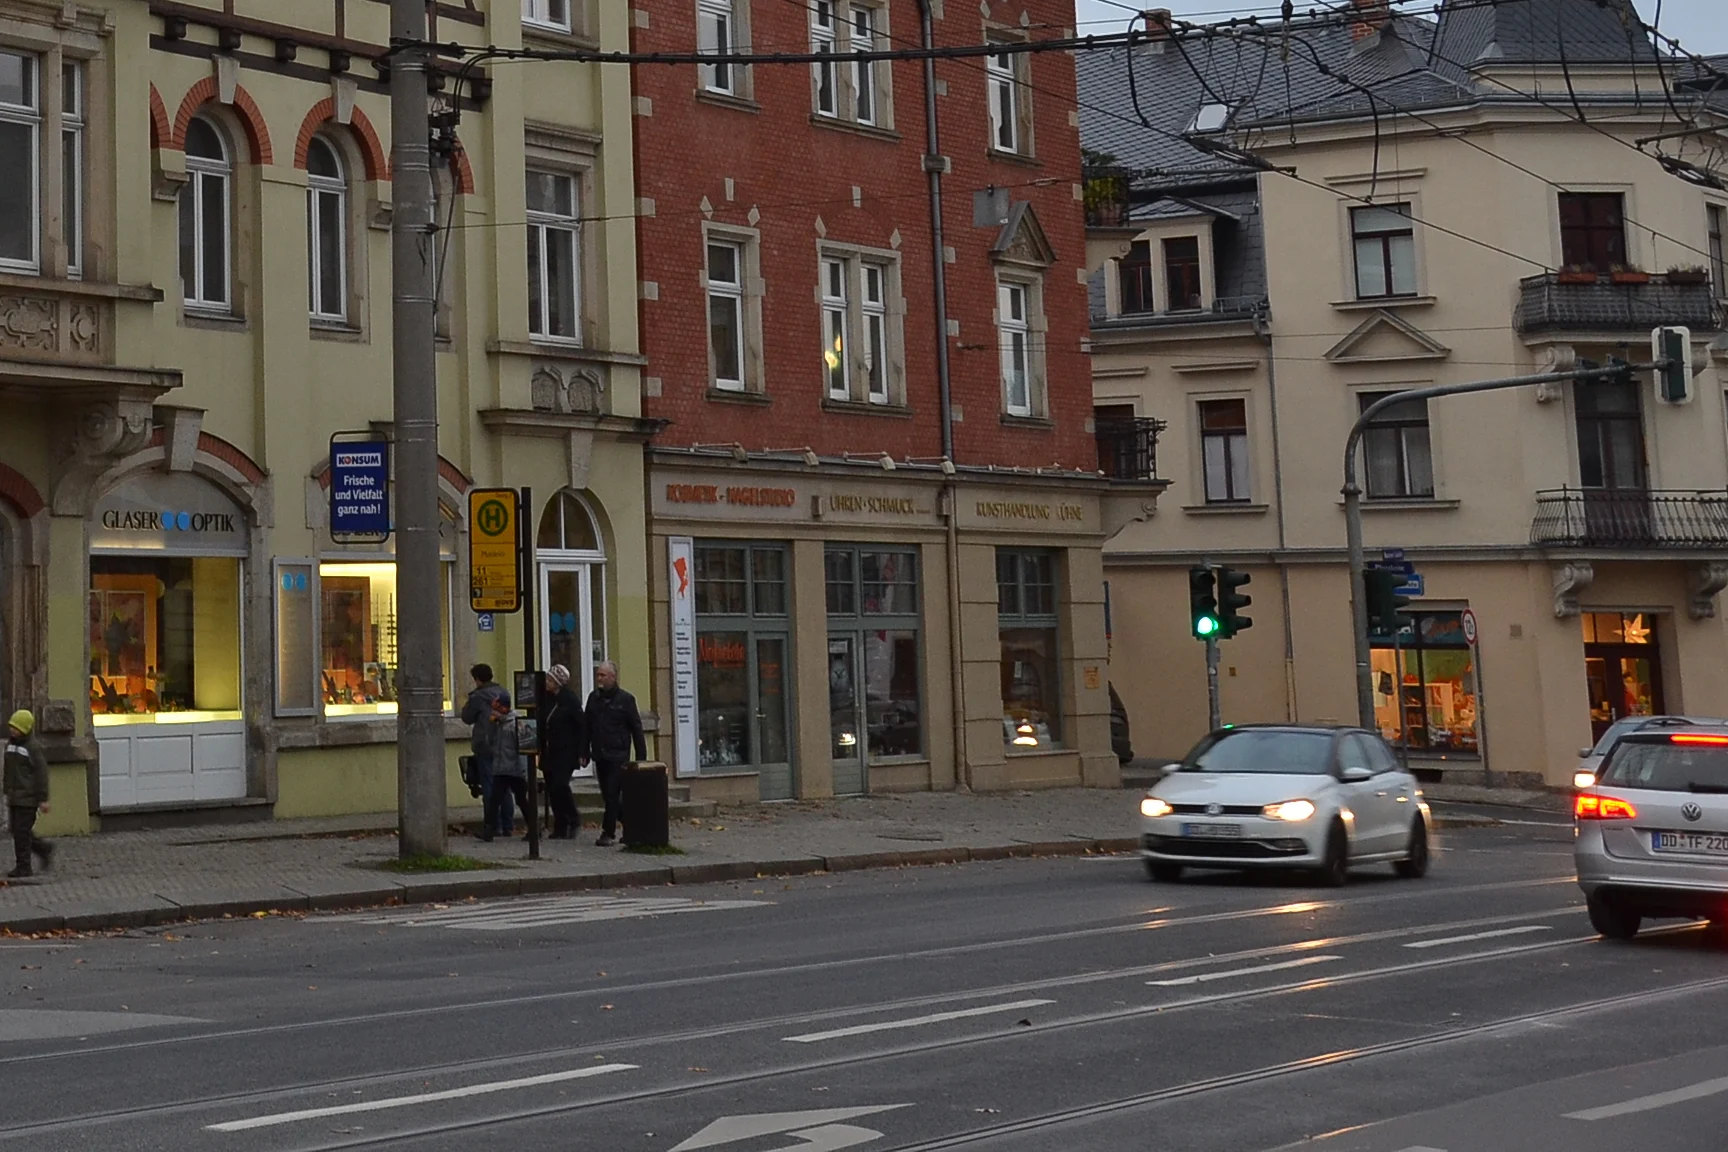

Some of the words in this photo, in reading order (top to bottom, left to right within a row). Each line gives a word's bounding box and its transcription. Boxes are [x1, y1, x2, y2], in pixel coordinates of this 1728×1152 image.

[338, 455, 379, 465] KONSUM
[344, 475, 374, 486] Frische
[335, 489, 351, 500] und
[353, 489, 383, 500] Vielfalt
[337, 506, 358, 517] ganz
[360, 504, 381, 514] nah!
[830, 496, 862, 512] UHREN
[868, 496, 914, 514] SCHMUCK
[976, 501, 1050, 520] KUNSTHANDLUNG
[103, 510, 159, 530] GLASER
[192, 512, 234, 532] OPTIK
[485, 508, 500, 528] H
[476, 567, 487, 575] 11
[1661, 834, 1677, 847] DD
[1688, 836, 1702, 848] TF
